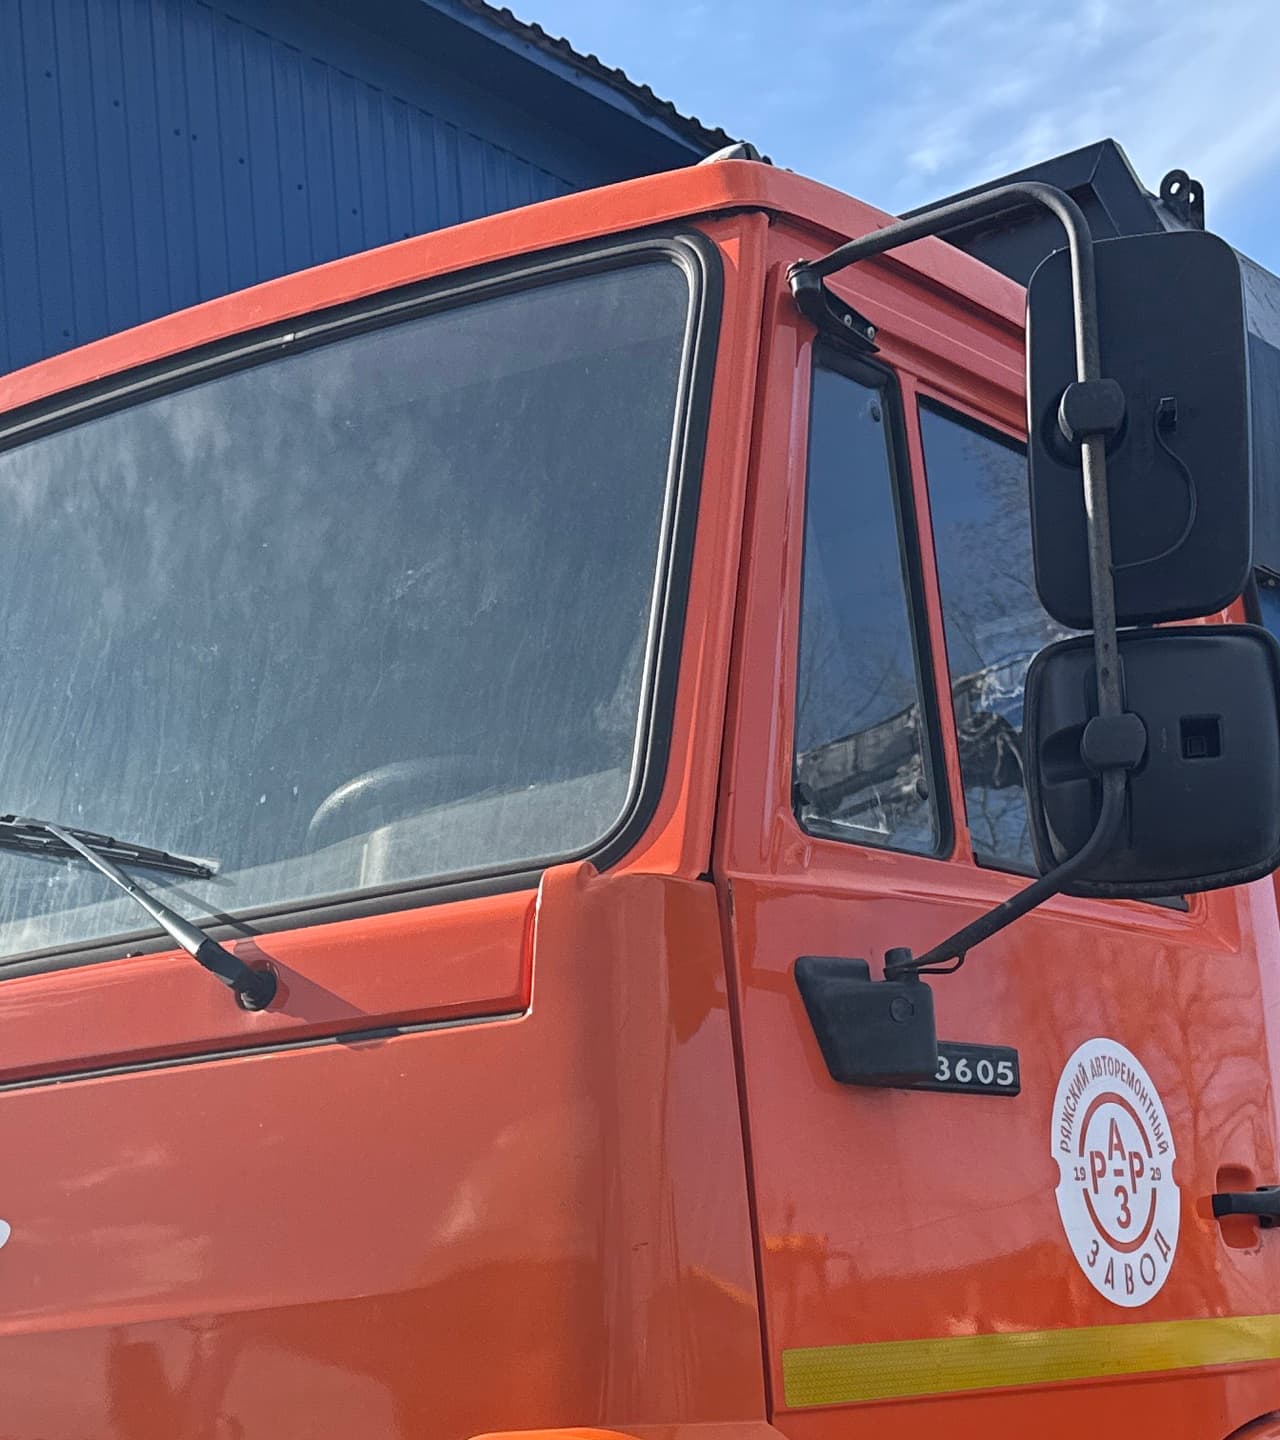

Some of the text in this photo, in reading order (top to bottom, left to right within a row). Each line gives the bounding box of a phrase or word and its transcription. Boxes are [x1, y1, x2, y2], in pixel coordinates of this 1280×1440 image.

[1060, 1055, 1169, 1156] РЯЖСКИЙ АВТОРЕМОНТНЫЙ
[1074, 1166, 1086, 1181] 19
[1150, 1166, 1162, 1181] 29
[1087, 1228, 1171, 1295] ЗАВОД
